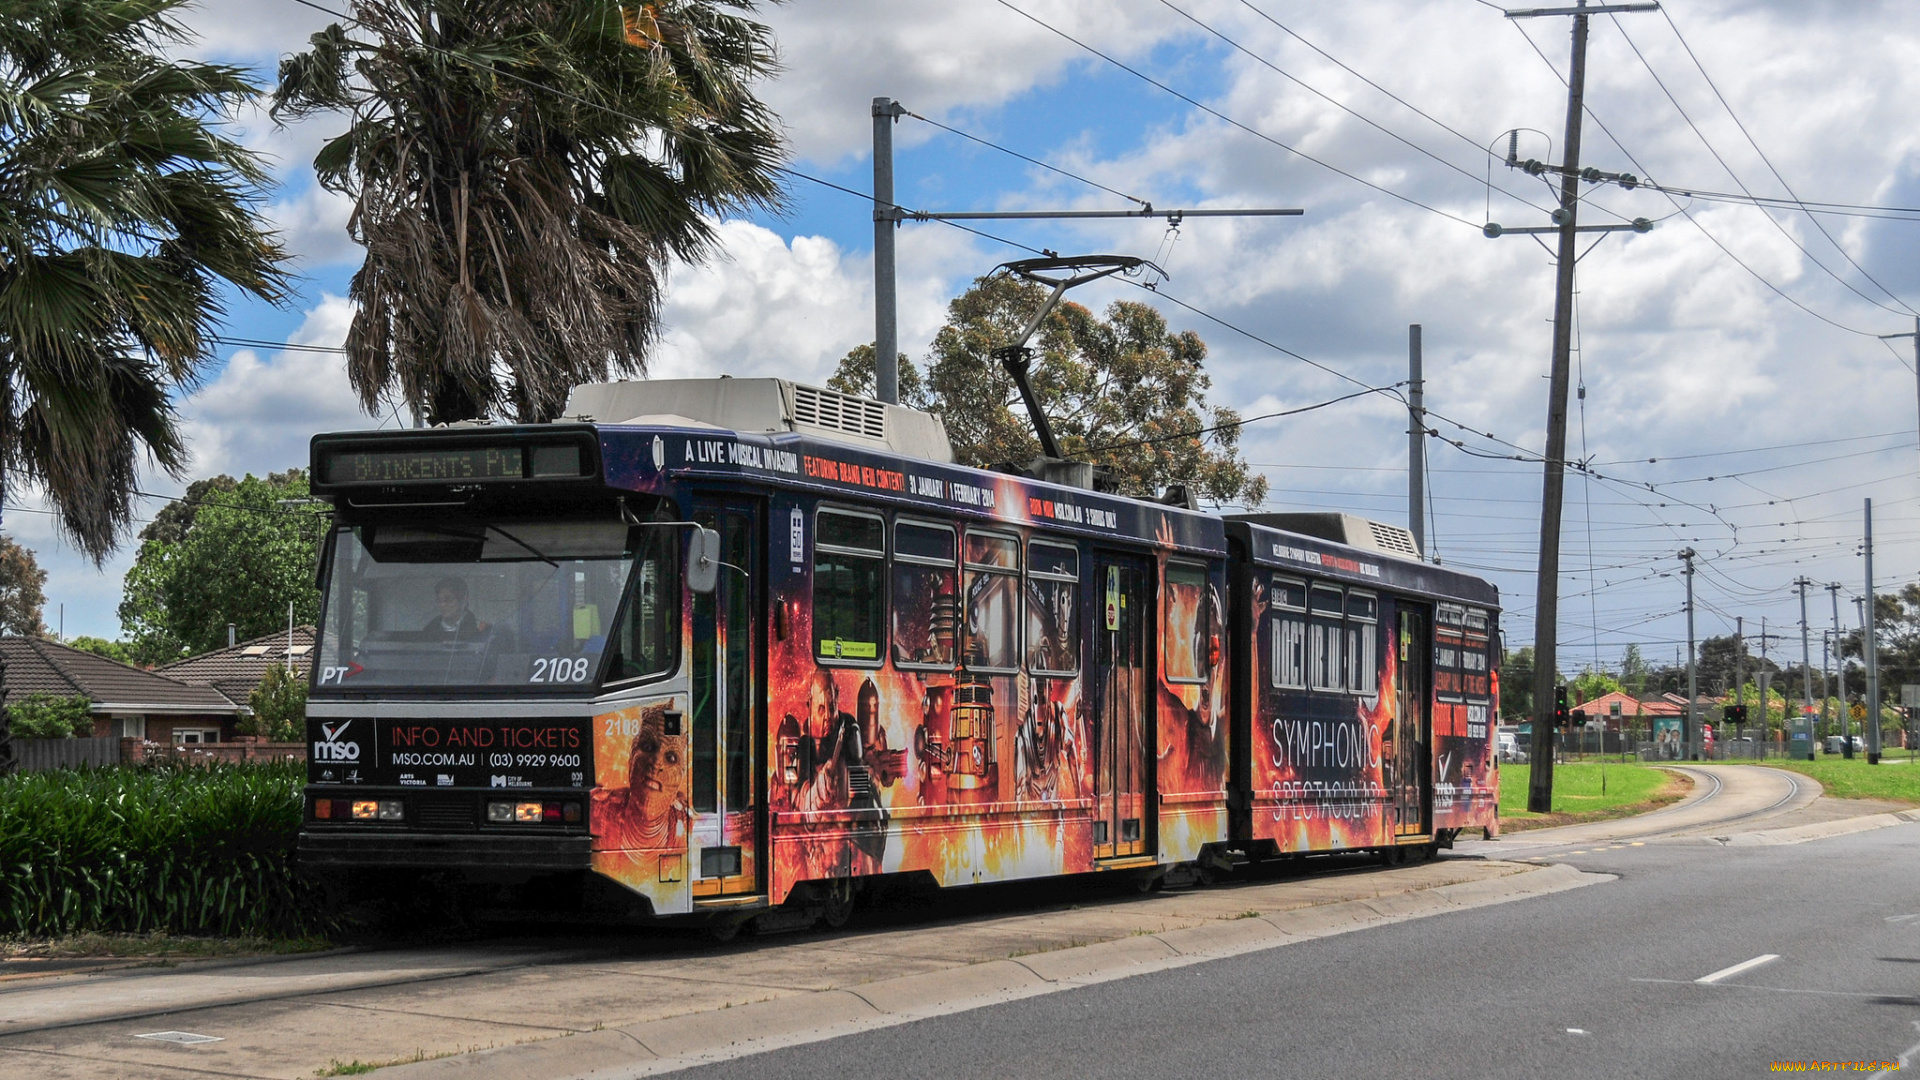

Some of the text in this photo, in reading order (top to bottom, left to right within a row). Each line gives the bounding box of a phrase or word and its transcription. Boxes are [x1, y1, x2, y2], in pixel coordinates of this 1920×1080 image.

[685, 440, 695, 461] A
[697, 441, 725, 463] LIVE
[727, 443, 763, 469] MUSICAL
[763, 448, 798, 474] INVASION!
[803, 455, 838, 480] FEATURING
[839, 461, 860, 485] BRAND
[861, 466, 876, 487] NEW
[876, 469, 905, 492] CONTENT!
[918, 476, 943, 499] JANUARY
[953, 483, 980, 506] FEBRUARY
[530, 658, 588, 682] 2108
[393, 727, 580, 748] INFO AND TICKETS
[605, 719, 640, 736] 2108
[314, 741, 360, 760] mso
[1272, 718, 1379, 769] SYMPHONIC
[392, 752, 580, 768] MSO.COM.AU (03) 9929 9600
[1272, 781, 1380, 822] SPECTACULAR
